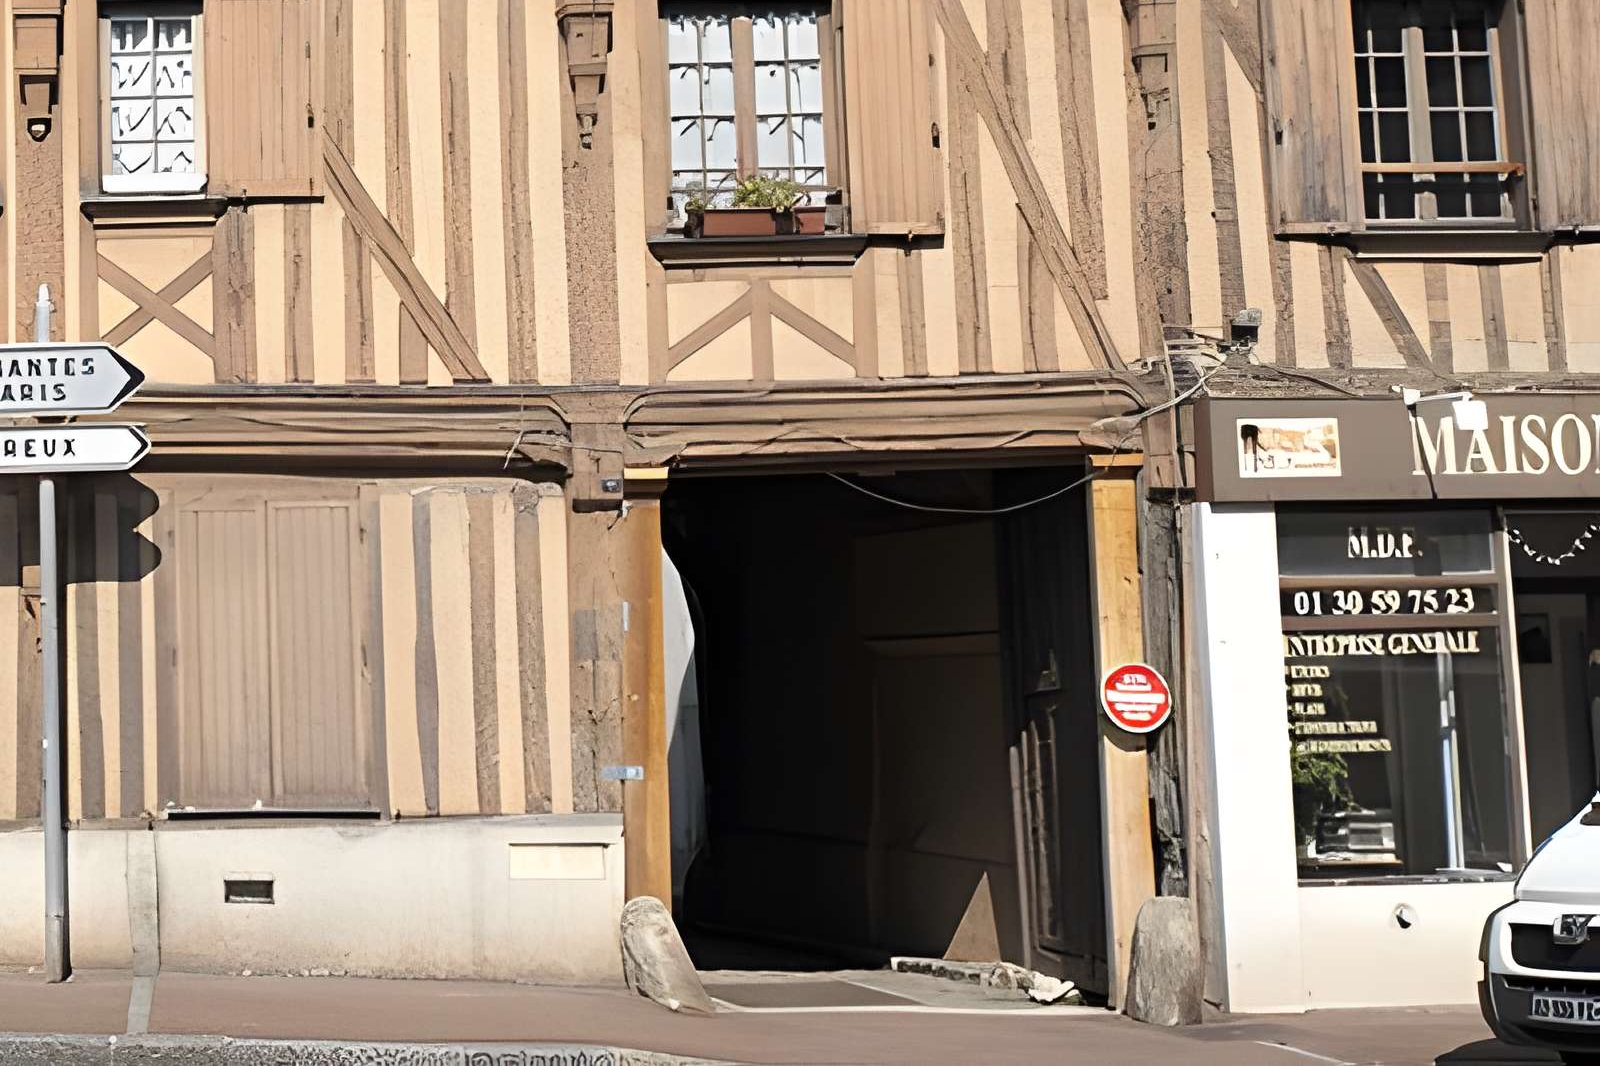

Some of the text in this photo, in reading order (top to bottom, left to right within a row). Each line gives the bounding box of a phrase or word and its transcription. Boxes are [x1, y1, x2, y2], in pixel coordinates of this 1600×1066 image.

[1408, 413, 1600, 476] MAISO
[1294, 587, 1476, 615] 01 30 59 75 23
